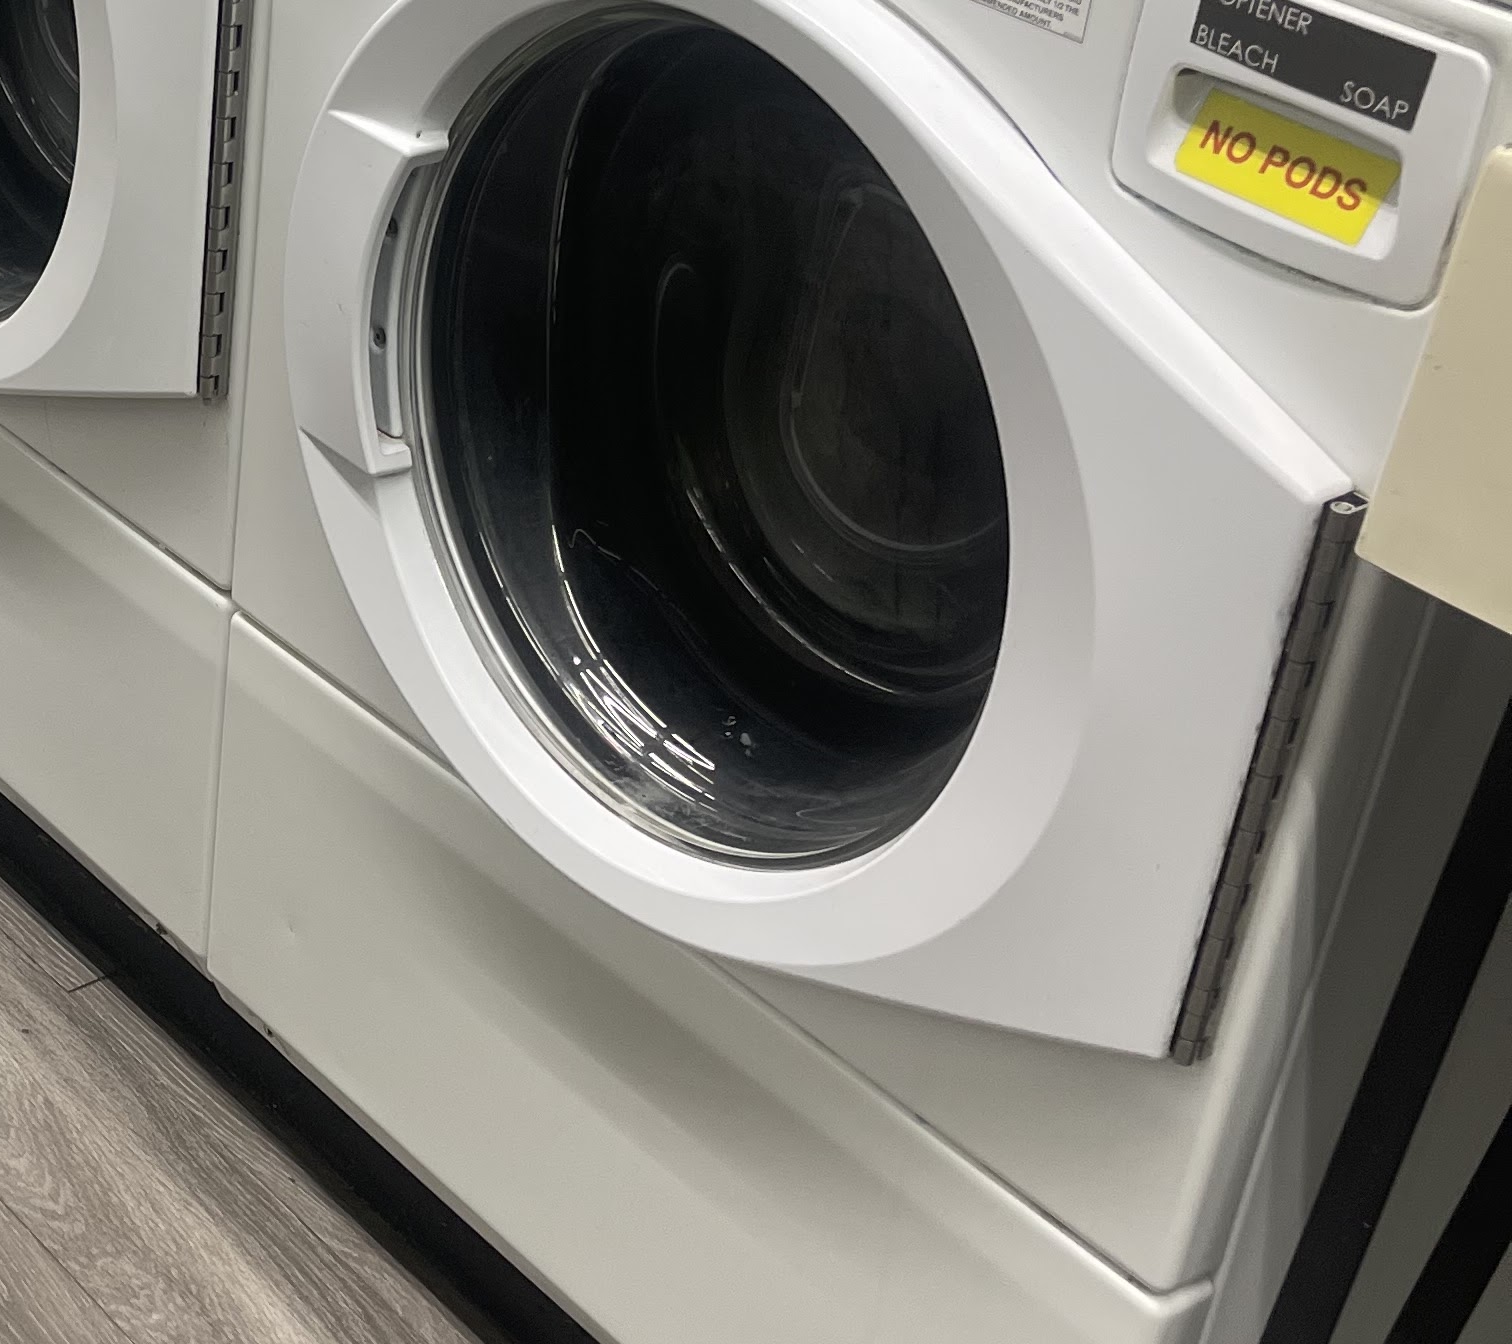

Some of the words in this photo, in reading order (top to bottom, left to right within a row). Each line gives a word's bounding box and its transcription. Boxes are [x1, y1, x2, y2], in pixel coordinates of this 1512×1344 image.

[1194, 22, 1280, 74] BLEACH
[1339, 79, 1410, 120] SOAP
[1198, 118, 1257, 165] NO
[1258, 143, 1368, 212] PODS
